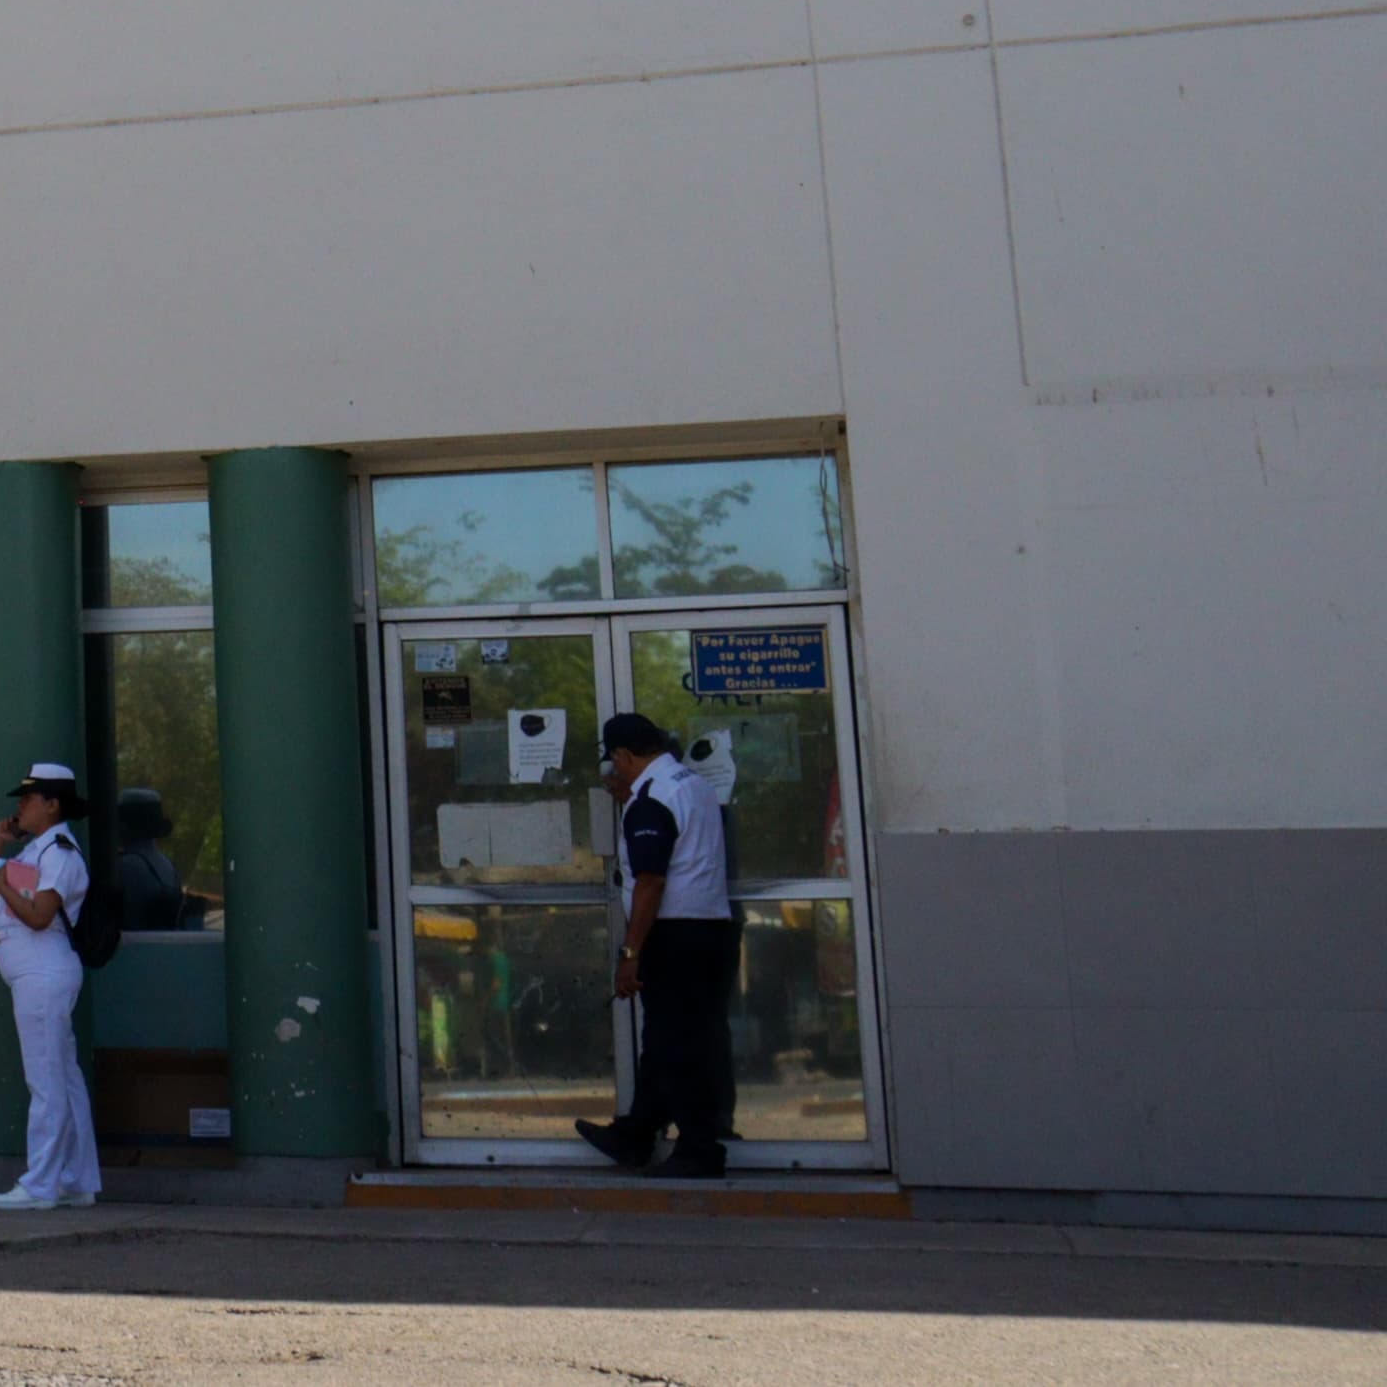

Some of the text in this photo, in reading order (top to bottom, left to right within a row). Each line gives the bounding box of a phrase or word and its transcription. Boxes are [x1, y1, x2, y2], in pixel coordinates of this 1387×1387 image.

[728, 634, 765, 646] Favor
[769, 633, 820, 647] Apague
[718, 648, 800, 662] su cigarrillo
[705, 664, 742, 676] antes
[747, 663, 763, 674] de
[725, 676, 776, 688] Gracias
